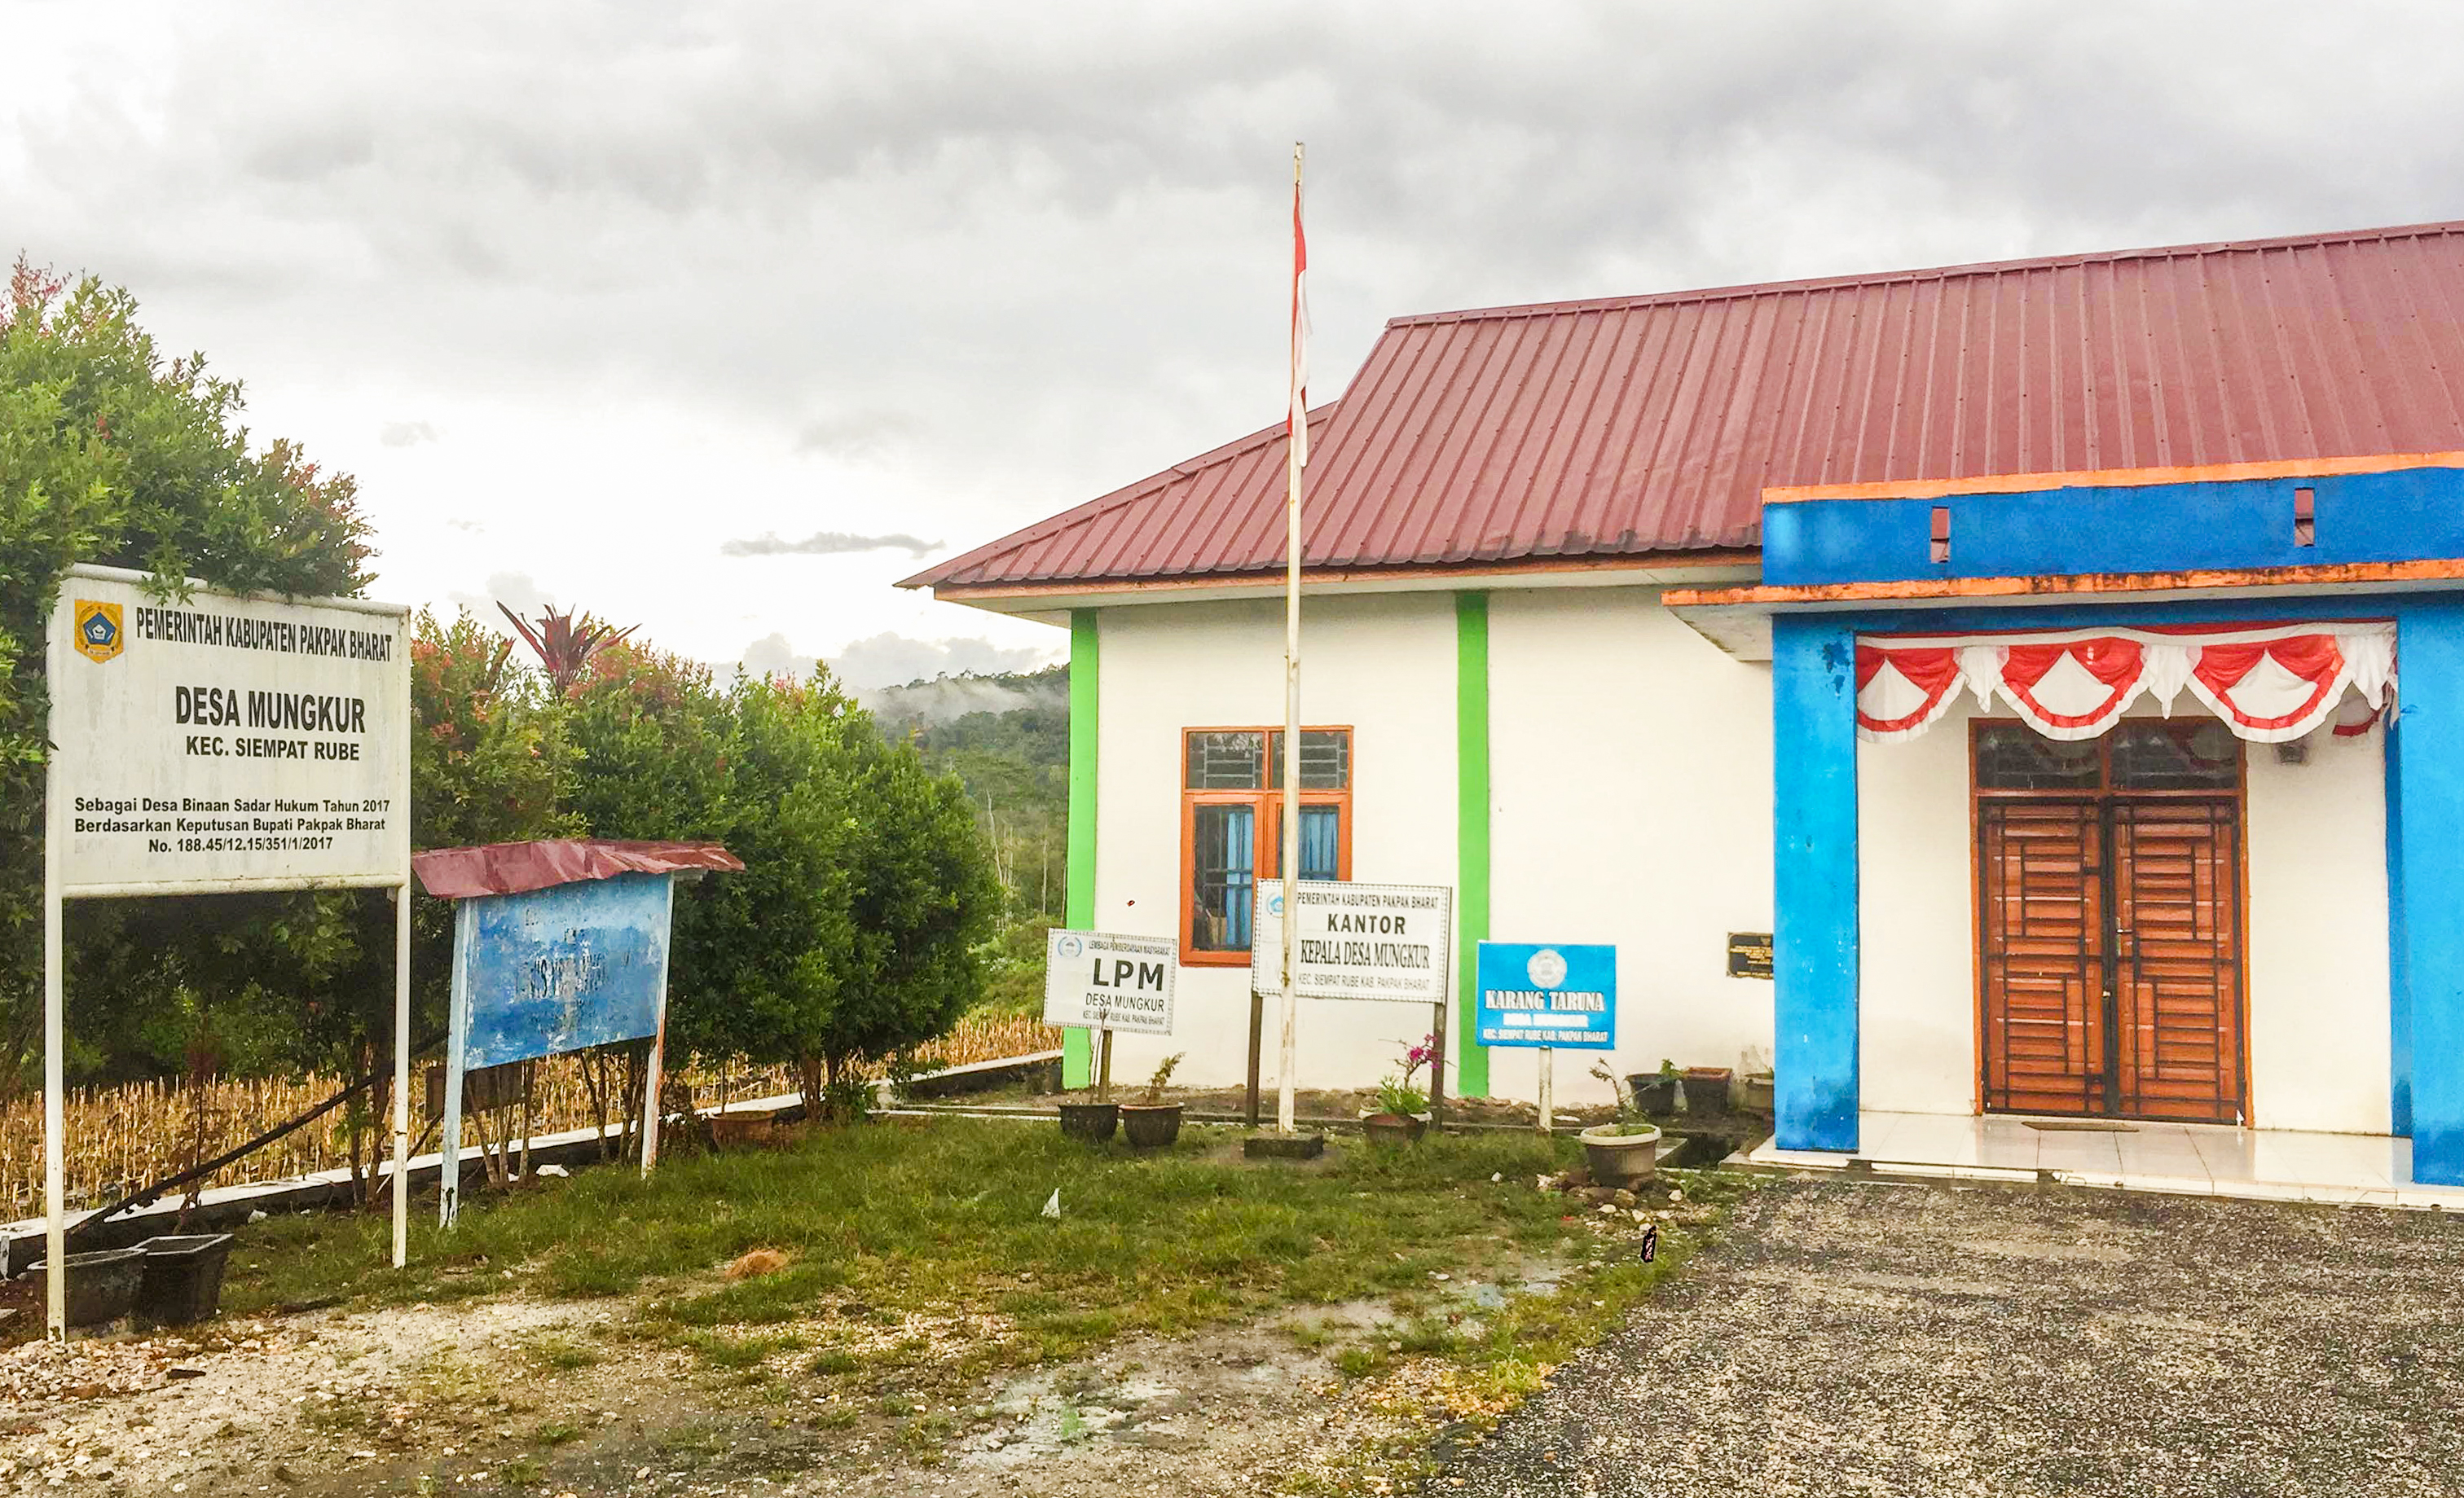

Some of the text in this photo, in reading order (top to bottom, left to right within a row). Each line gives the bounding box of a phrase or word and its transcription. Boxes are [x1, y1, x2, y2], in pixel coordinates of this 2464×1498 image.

[136, 607, 392, 662] PEMERINTAH KABUPATEN PAKPAK BHARAT
[175, 686, 366, 734] DESA MUNGKUR
[186, 736, 359, 761] KEC. SIEMPAT RUBE
[74, 797, 390, 815] Sebagai Desa Binaan Sadar Hukum Tahun 2017
[74, 818, 385, 834] Berdasarkan Keputusan Bupati Pakpak Bharat
[148, 837, 333, 853] No. 188.45/12.15/351/1/2017
[1297, 892, 1438, 910] PEMERINTAH KABUPATEN PAKPAK BHARAT
[1327, 913, 1406, 934] KANTOR
[1300, 939, 1430, 969] KEPALA DESA MUNGKUR
[1093, 958, 1164, 991] LPM
[1085, 992, 1164, 1013] DESA MUNGKUR
[1485, 989, 1605, 1012] KARANG TARUNA
